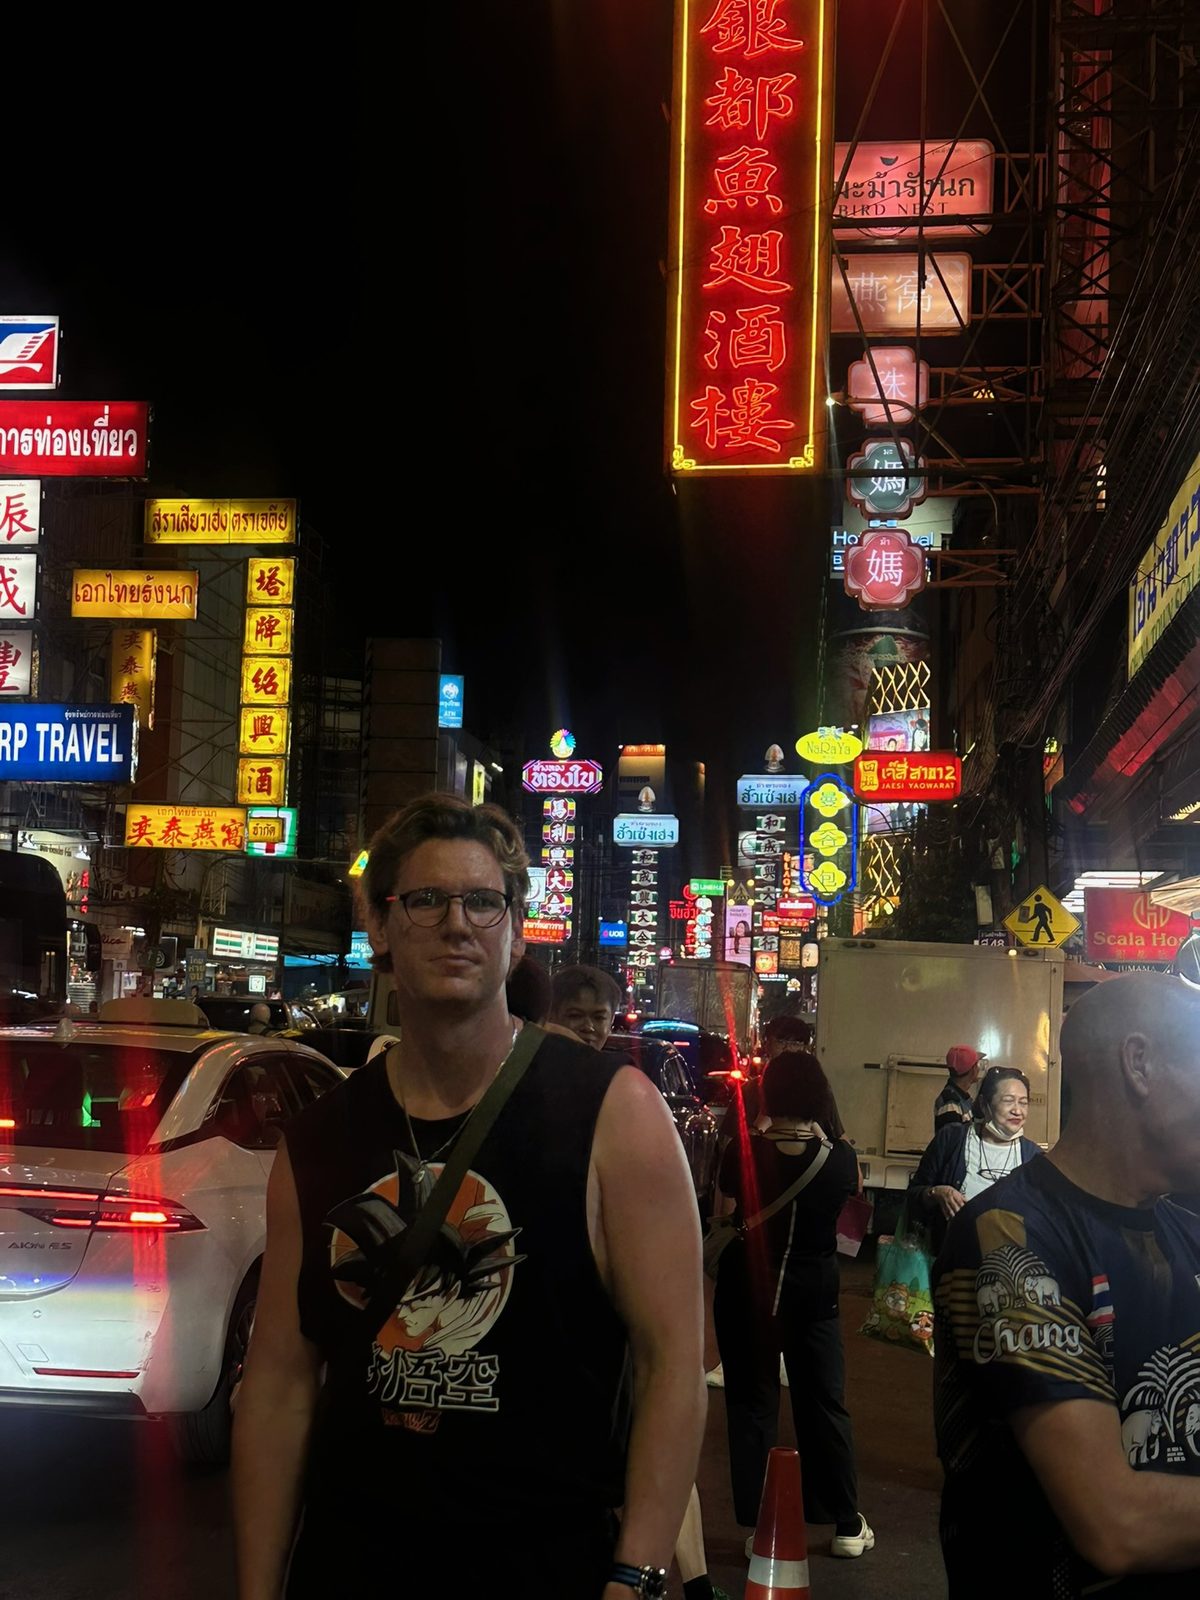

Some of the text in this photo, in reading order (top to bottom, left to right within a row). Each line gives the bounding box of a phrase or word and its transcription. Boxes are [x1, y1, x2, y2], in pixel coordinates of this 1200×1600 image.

[838, 202, 948, 217] BIRD NEST
[866, 549, 904, 587] 媽
[36, 723, 123, 762] TRAVEL
[806, 740, 850, 755] NaRaYa
[945, 765, 956, 780] 2
[1093, 931, 1185, 948] Scala Hos
[973, 1318, 1083, 1364] Chang
[366, 1341, 500, 1412] 悟空
